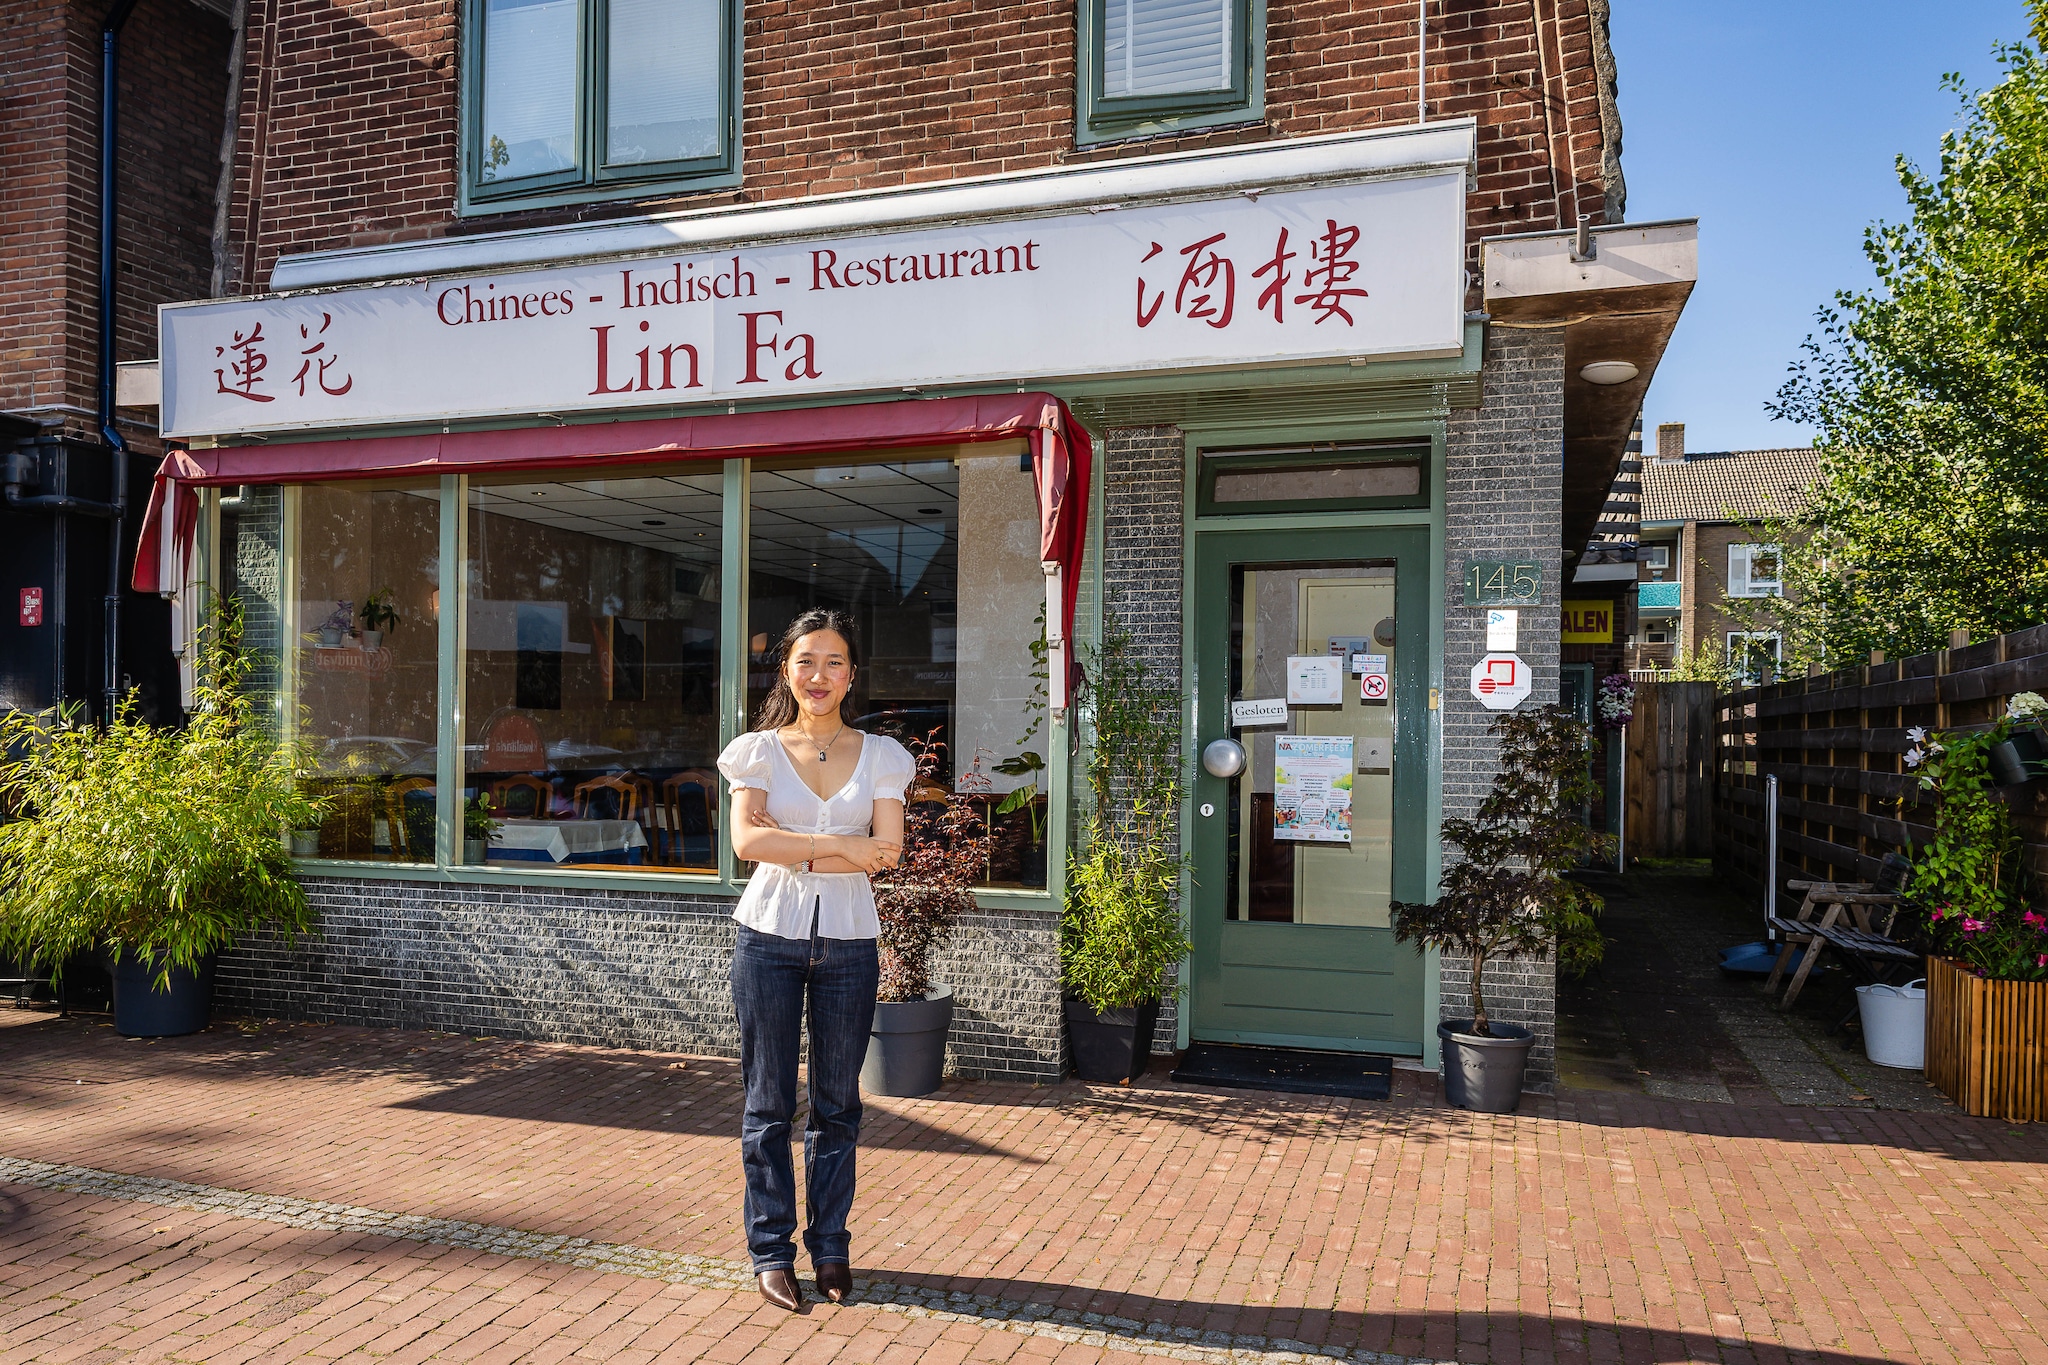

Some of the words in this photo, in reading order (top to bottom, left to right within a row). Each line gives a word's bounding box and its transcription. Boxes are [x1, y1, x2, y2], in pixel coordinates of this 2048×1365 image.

[437, 285, 574, 326] Chinees
[620, 256, 756, 309] Indisch
[809, 239, 1040, 291] Restaurant
[1136, 218, 1369, 329] 酒樓
[213, 313, 353, 403] 蓮花
[588, 320, 703, 395] Lin
[736, 310, 823, 385] Fa
[1472, 565, 1537, 600] 145
[1235, 704, 1284, 717] Gesloten
[1278, 742, 1350, 754] NAZOMERFEEST
